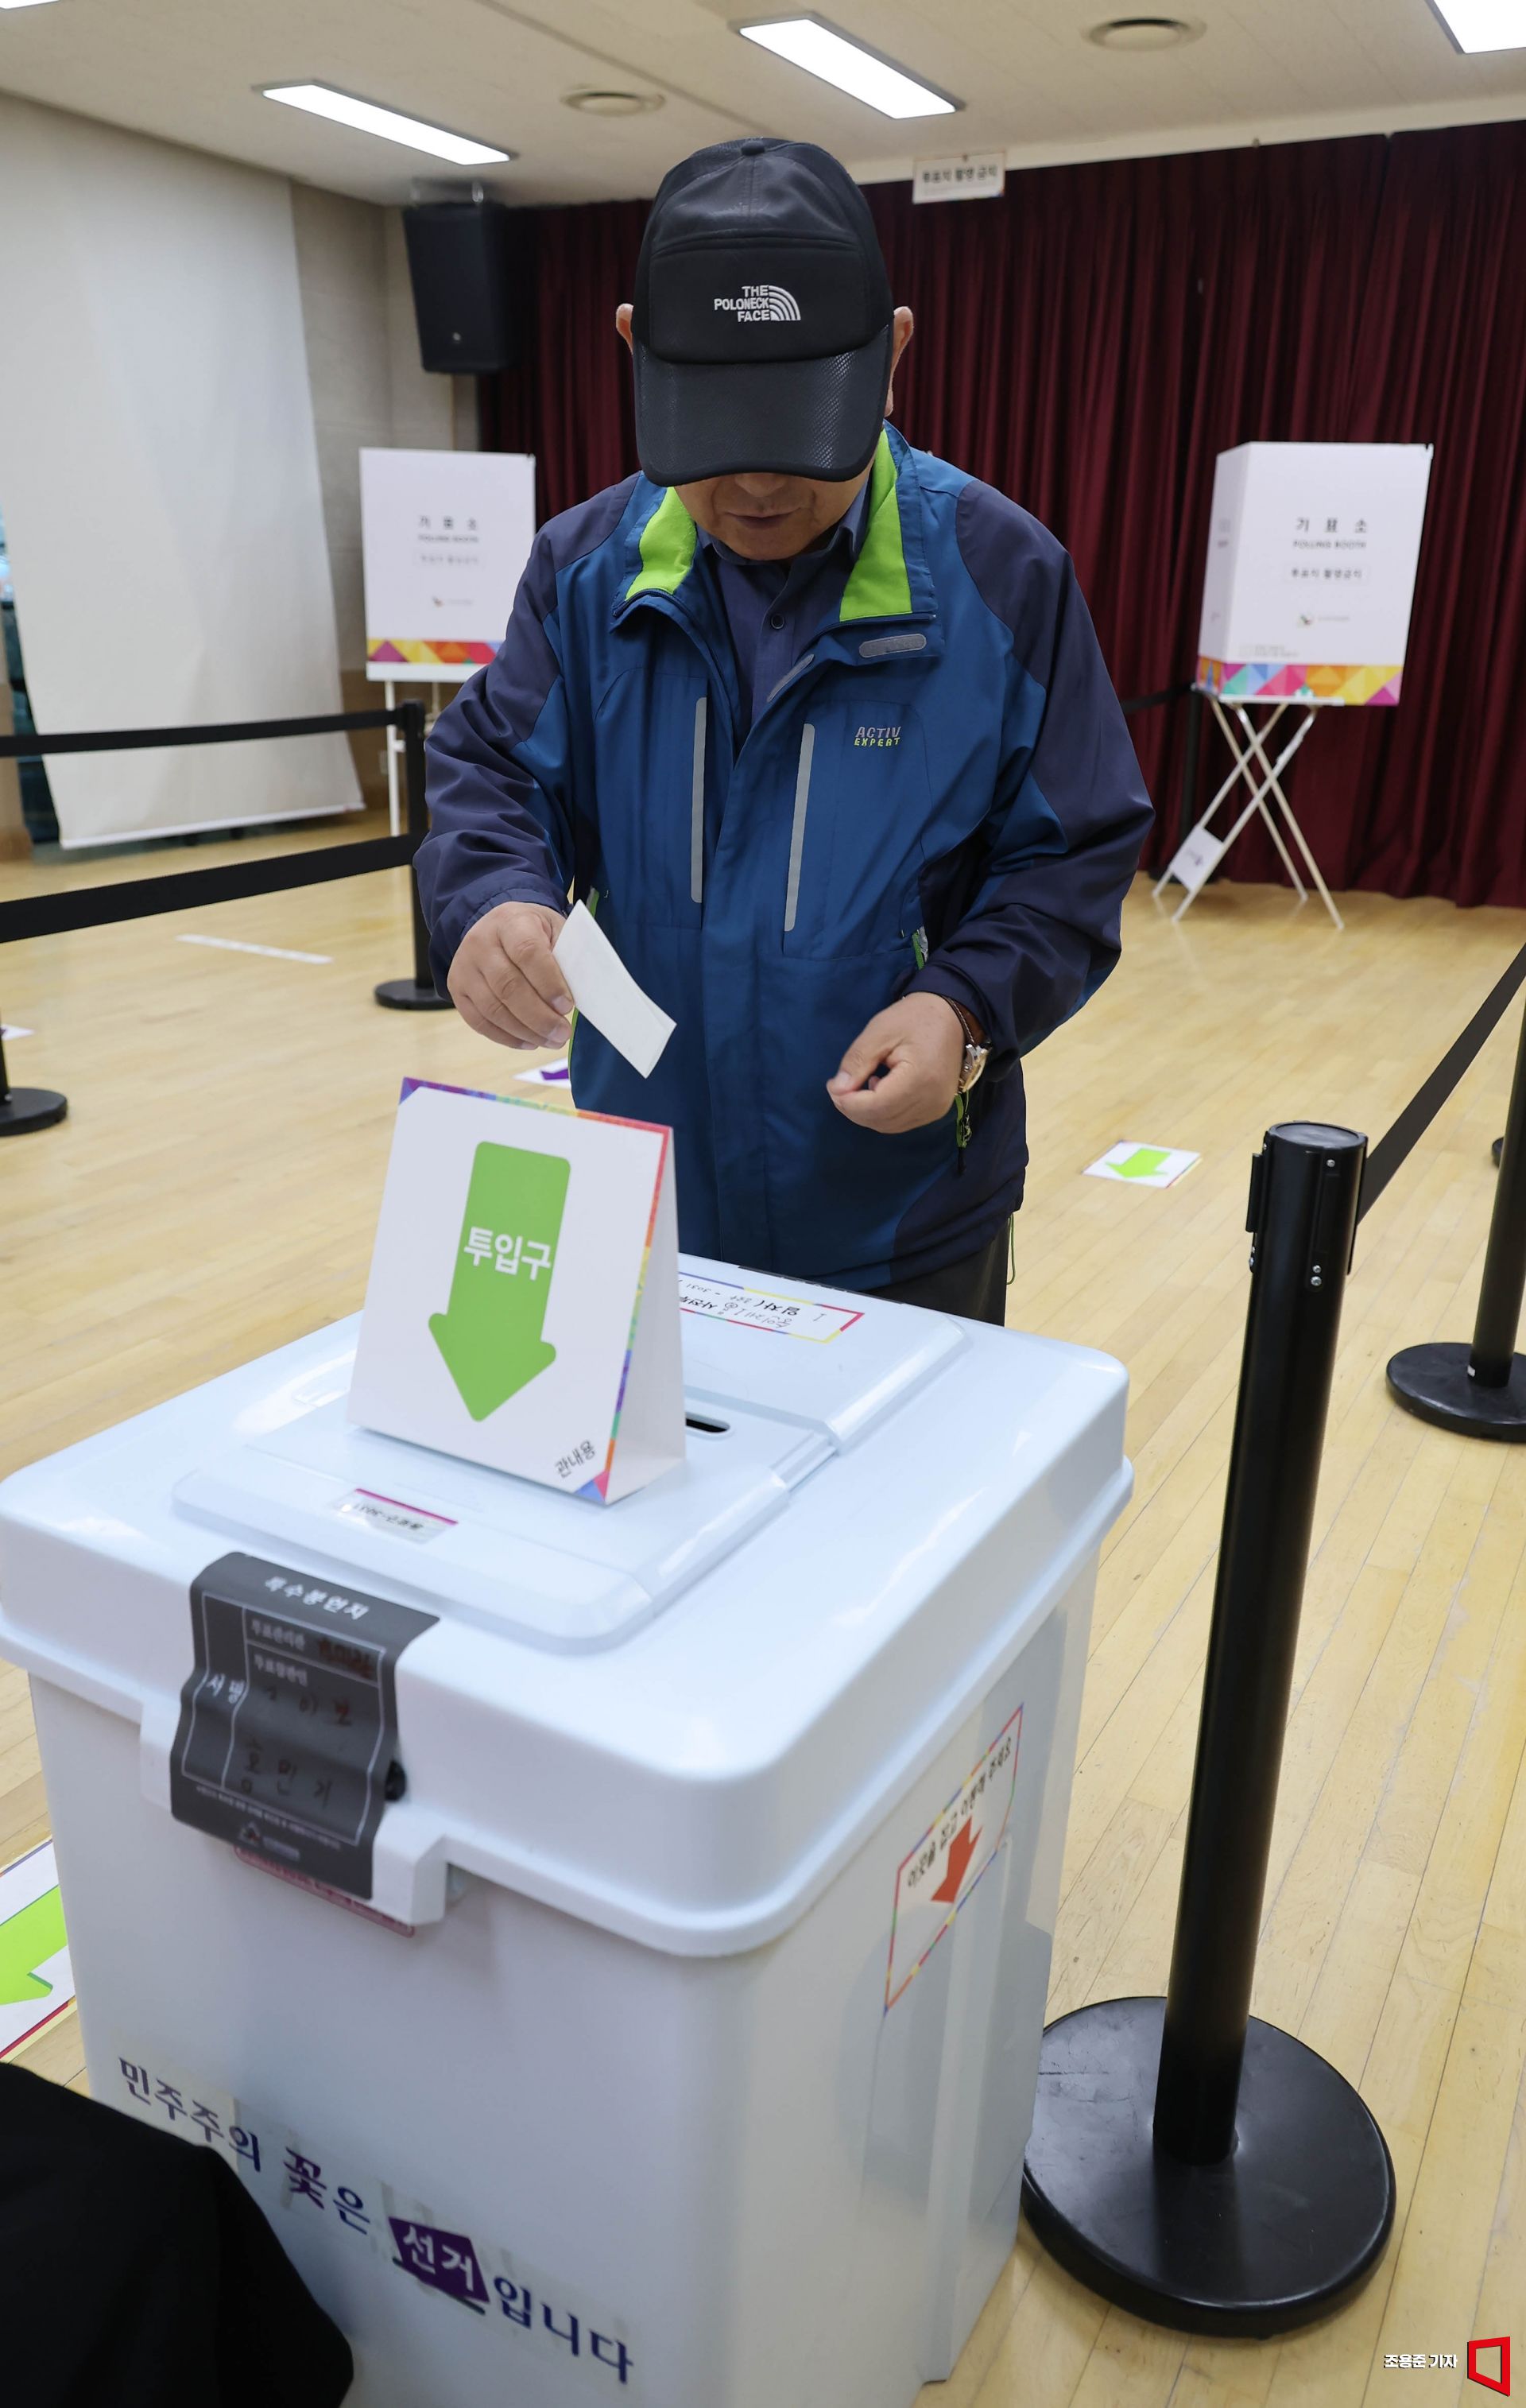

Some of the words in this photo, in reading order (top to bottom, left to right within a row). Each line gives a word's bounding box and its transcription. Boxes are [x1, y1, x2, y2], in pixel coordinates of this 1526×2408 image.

[742, 285, 769, 297] THE
[714, 297, 769, 311] POLONECK
[737, 309, 770, 322] FACE
[855, 726, 901, 739] ACTIV
[854, 737, 900, 747] EXPERT
[463, 1227, 551, 1281] 투입구
[554, 1440, 596, 1478] 관내용
[265, 1576, 370, 1620] 특수봉인지
[119, 2057, 261, 2172] 민주주의
[284, 2146, 370, 2235] 꽃은
